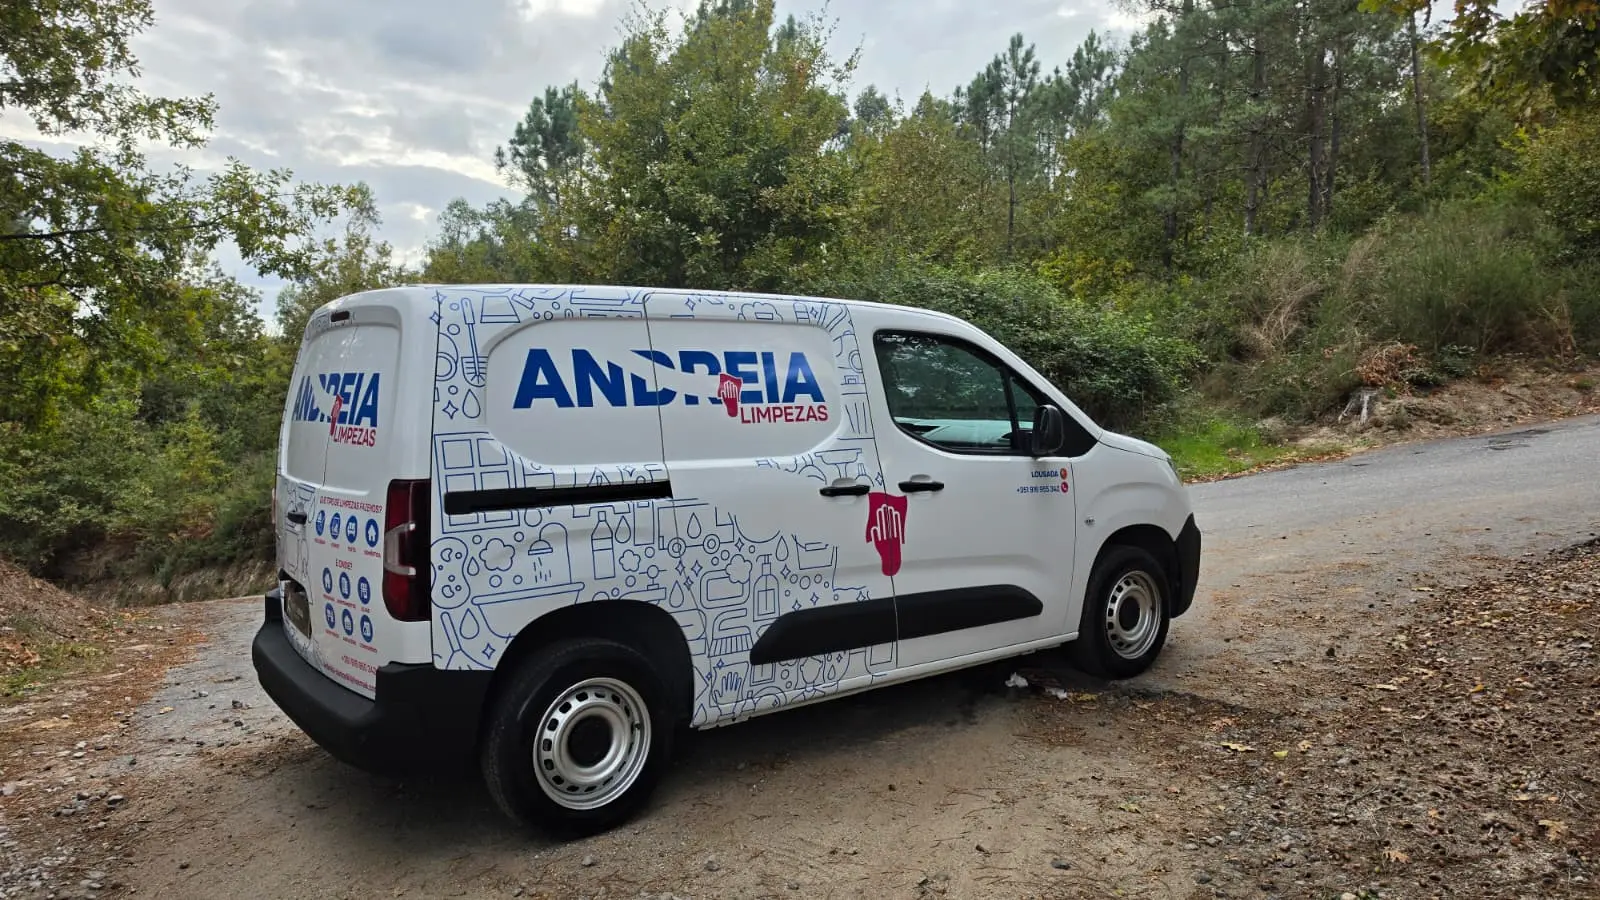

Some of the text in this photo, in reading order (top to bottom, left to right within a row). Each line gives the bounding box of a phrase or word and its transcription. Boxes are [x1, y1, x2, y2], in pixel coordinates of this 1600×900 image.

[513, 348, 826, 409] ANDREIA
[292, 372, 380, 428] ANDREIA
[740, 404, 828, 424] LIMPEZAS
[334, 426, 376, 447] LIMPEZAS
[1031, 470, 1058, 478] LOUSADA
